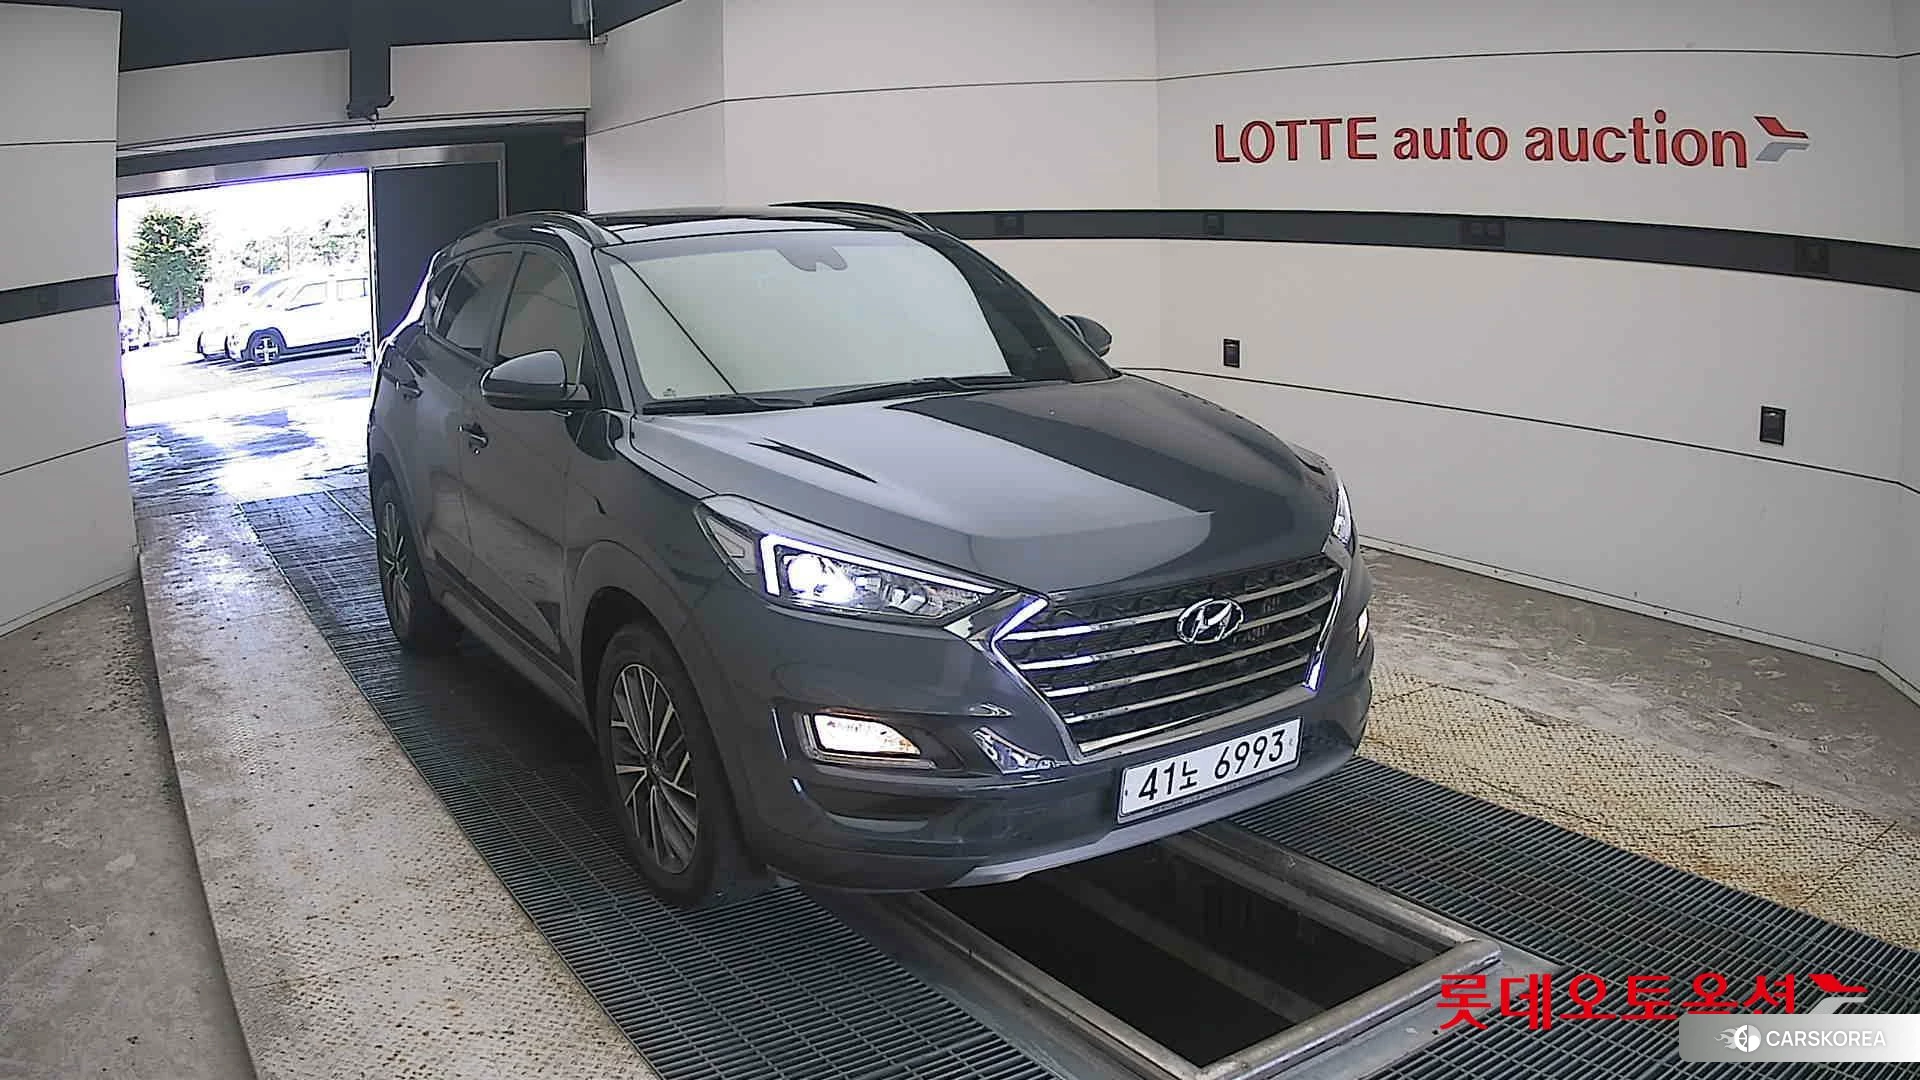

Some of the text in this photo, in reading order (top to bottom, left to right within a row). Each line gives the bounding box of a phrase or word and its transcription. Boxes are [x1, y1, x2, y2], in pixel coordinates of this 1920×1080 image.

[1215, 109, 1749, 169] LOTTE auto auction
[1138, 729, 1285, 801] 41노 6993
